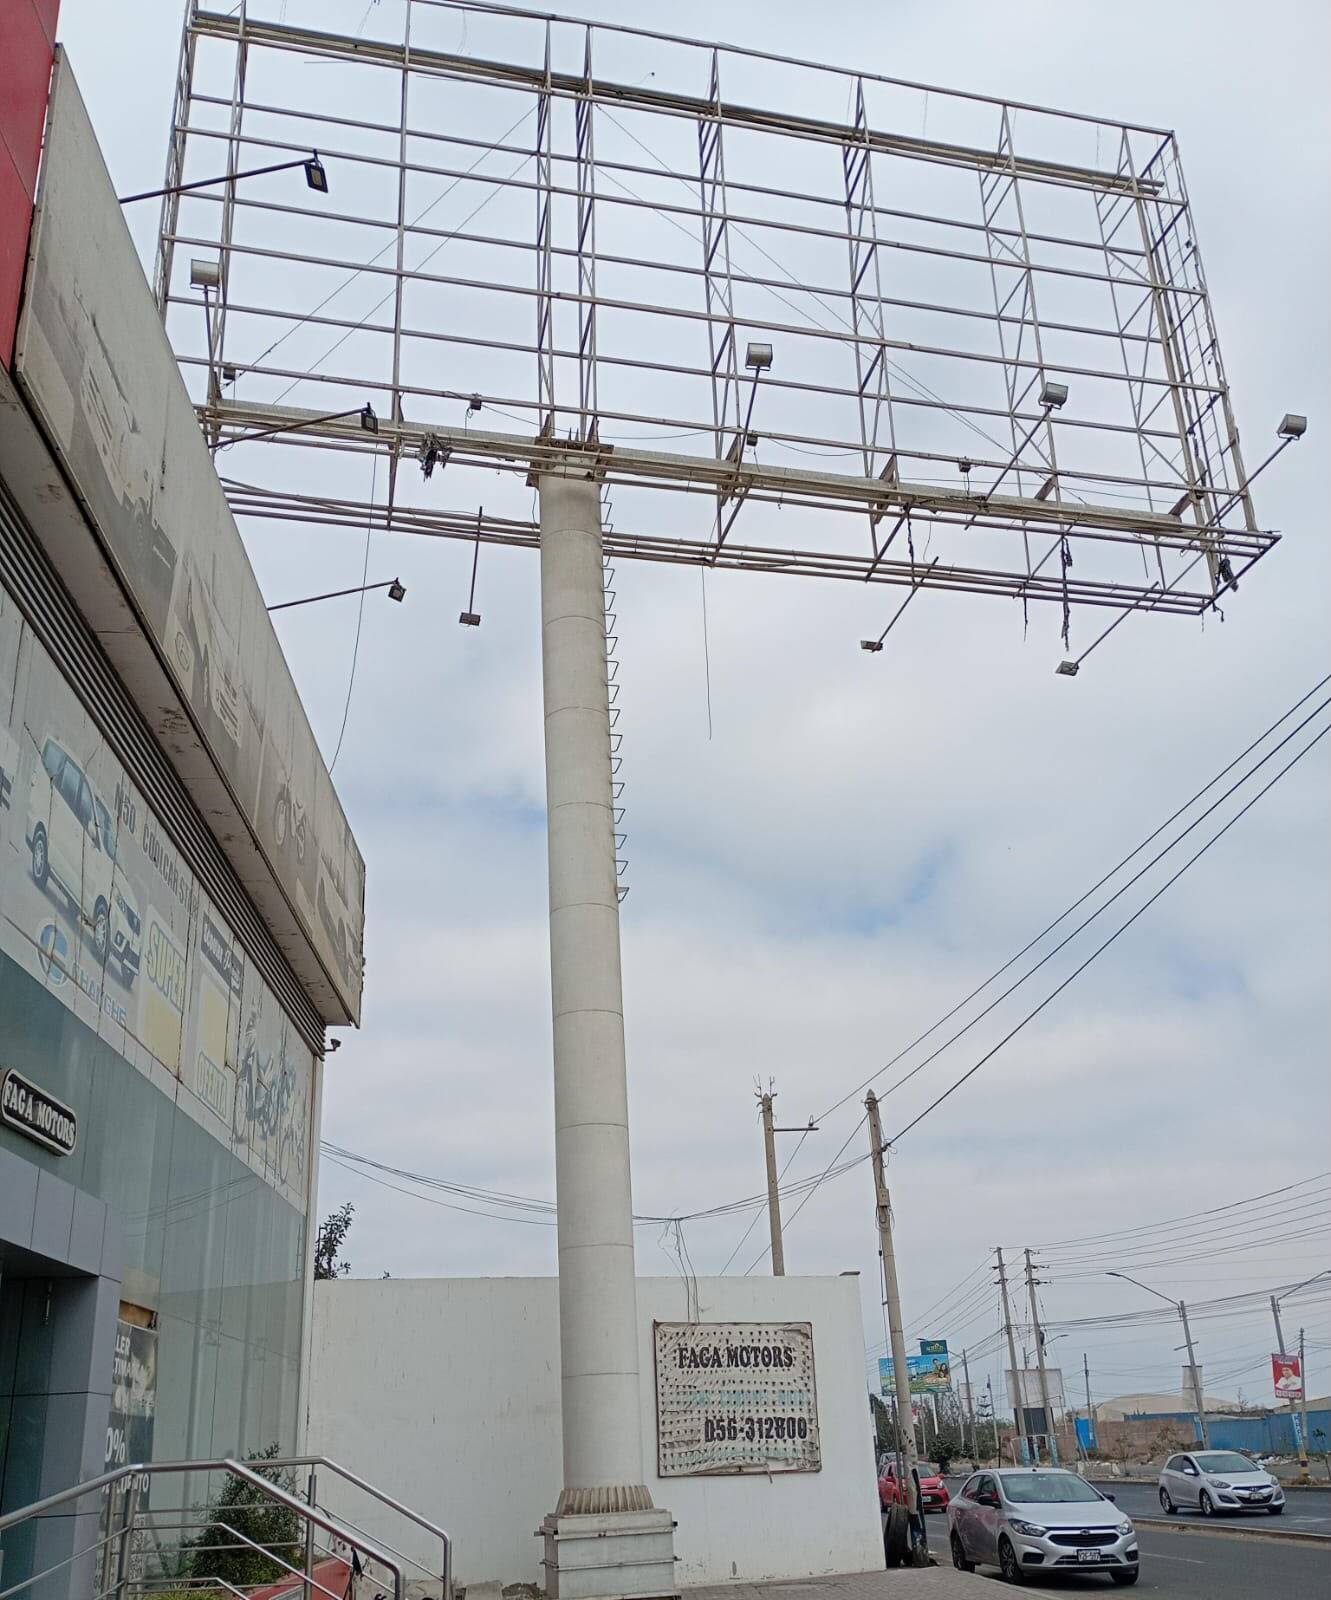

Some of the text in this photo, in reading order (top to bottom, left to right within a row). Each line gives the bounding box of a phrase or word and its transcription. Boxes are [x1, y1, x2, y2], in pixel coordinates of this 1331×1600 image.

[4, 1081, 75, 1147] FAGA MOTORS
[678, 1346, 793, 1368] FAGA MOTORS
[705, 1417, 808, 1442] 056-312800
